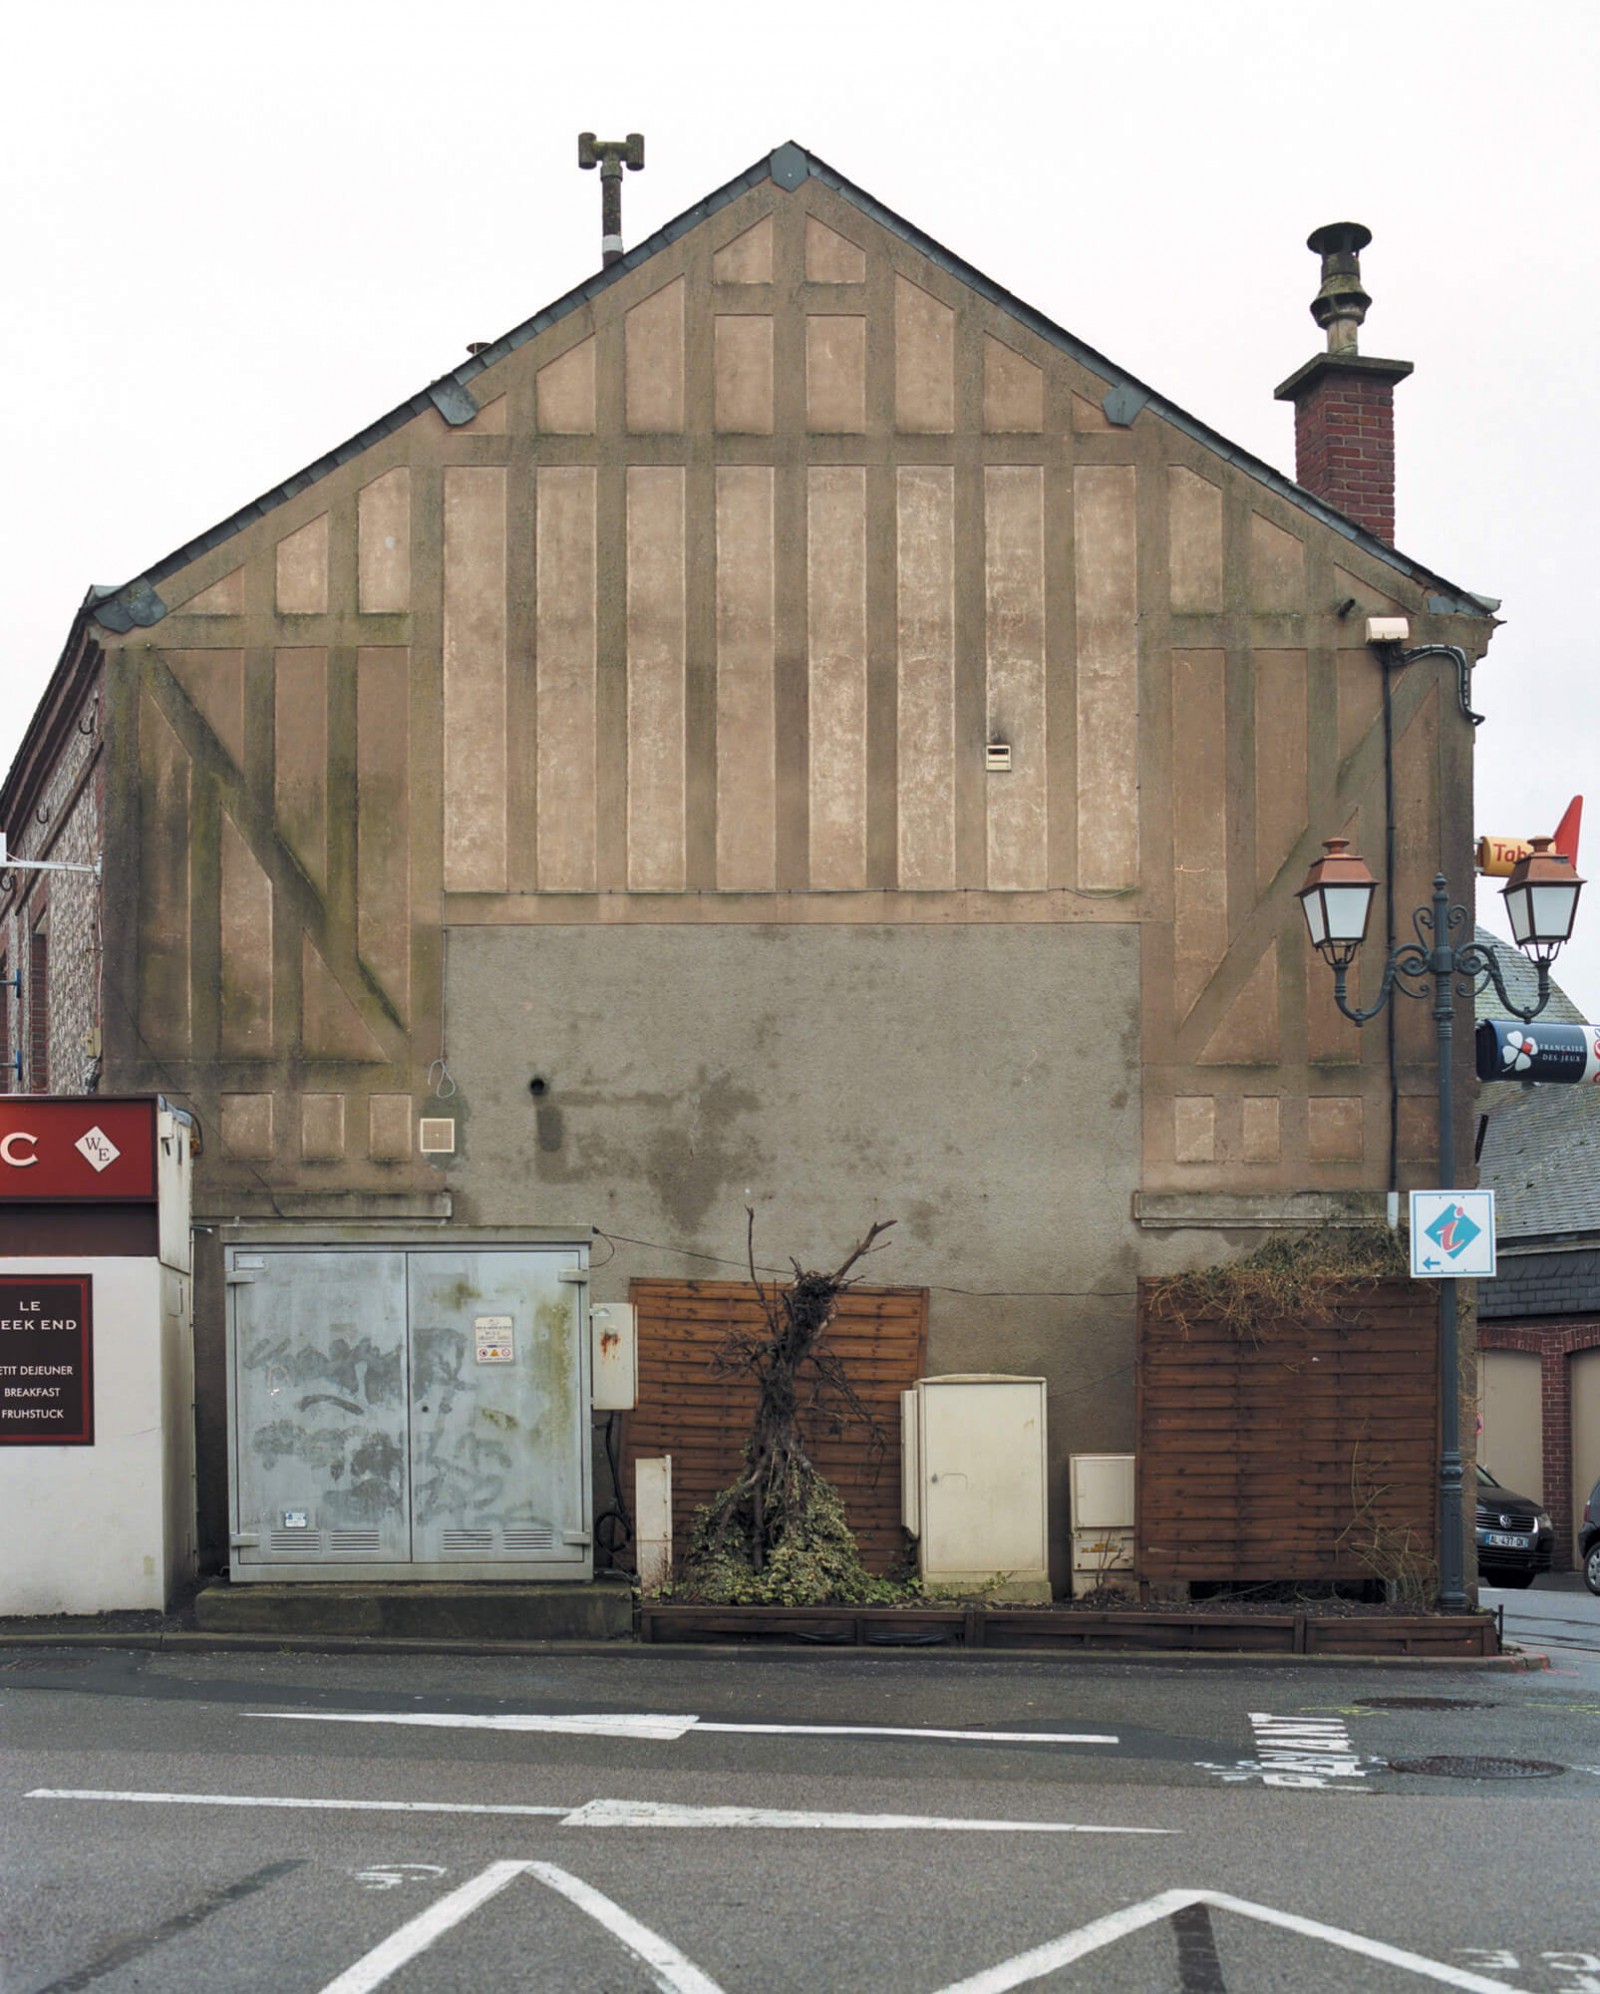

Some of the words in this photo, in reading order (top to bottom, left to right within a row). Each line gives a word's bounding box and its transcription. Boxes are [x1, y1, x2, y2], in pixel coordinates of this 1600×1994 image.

[1493, 843, 1528, 863] Tab
[1542, 1054, 1558, 1062] DES
[1561, 1055, 1580, 1063] JEUX
[19, 1300, 41, 1312] LE
[40, 1319, 77, 1331] END
[20, 1365, 74, 1377] DEJEUNER
[4, 1387, 61, 1398] BREAKFAST
[1, 1408, 64, 1420] FRUHSTUCK
